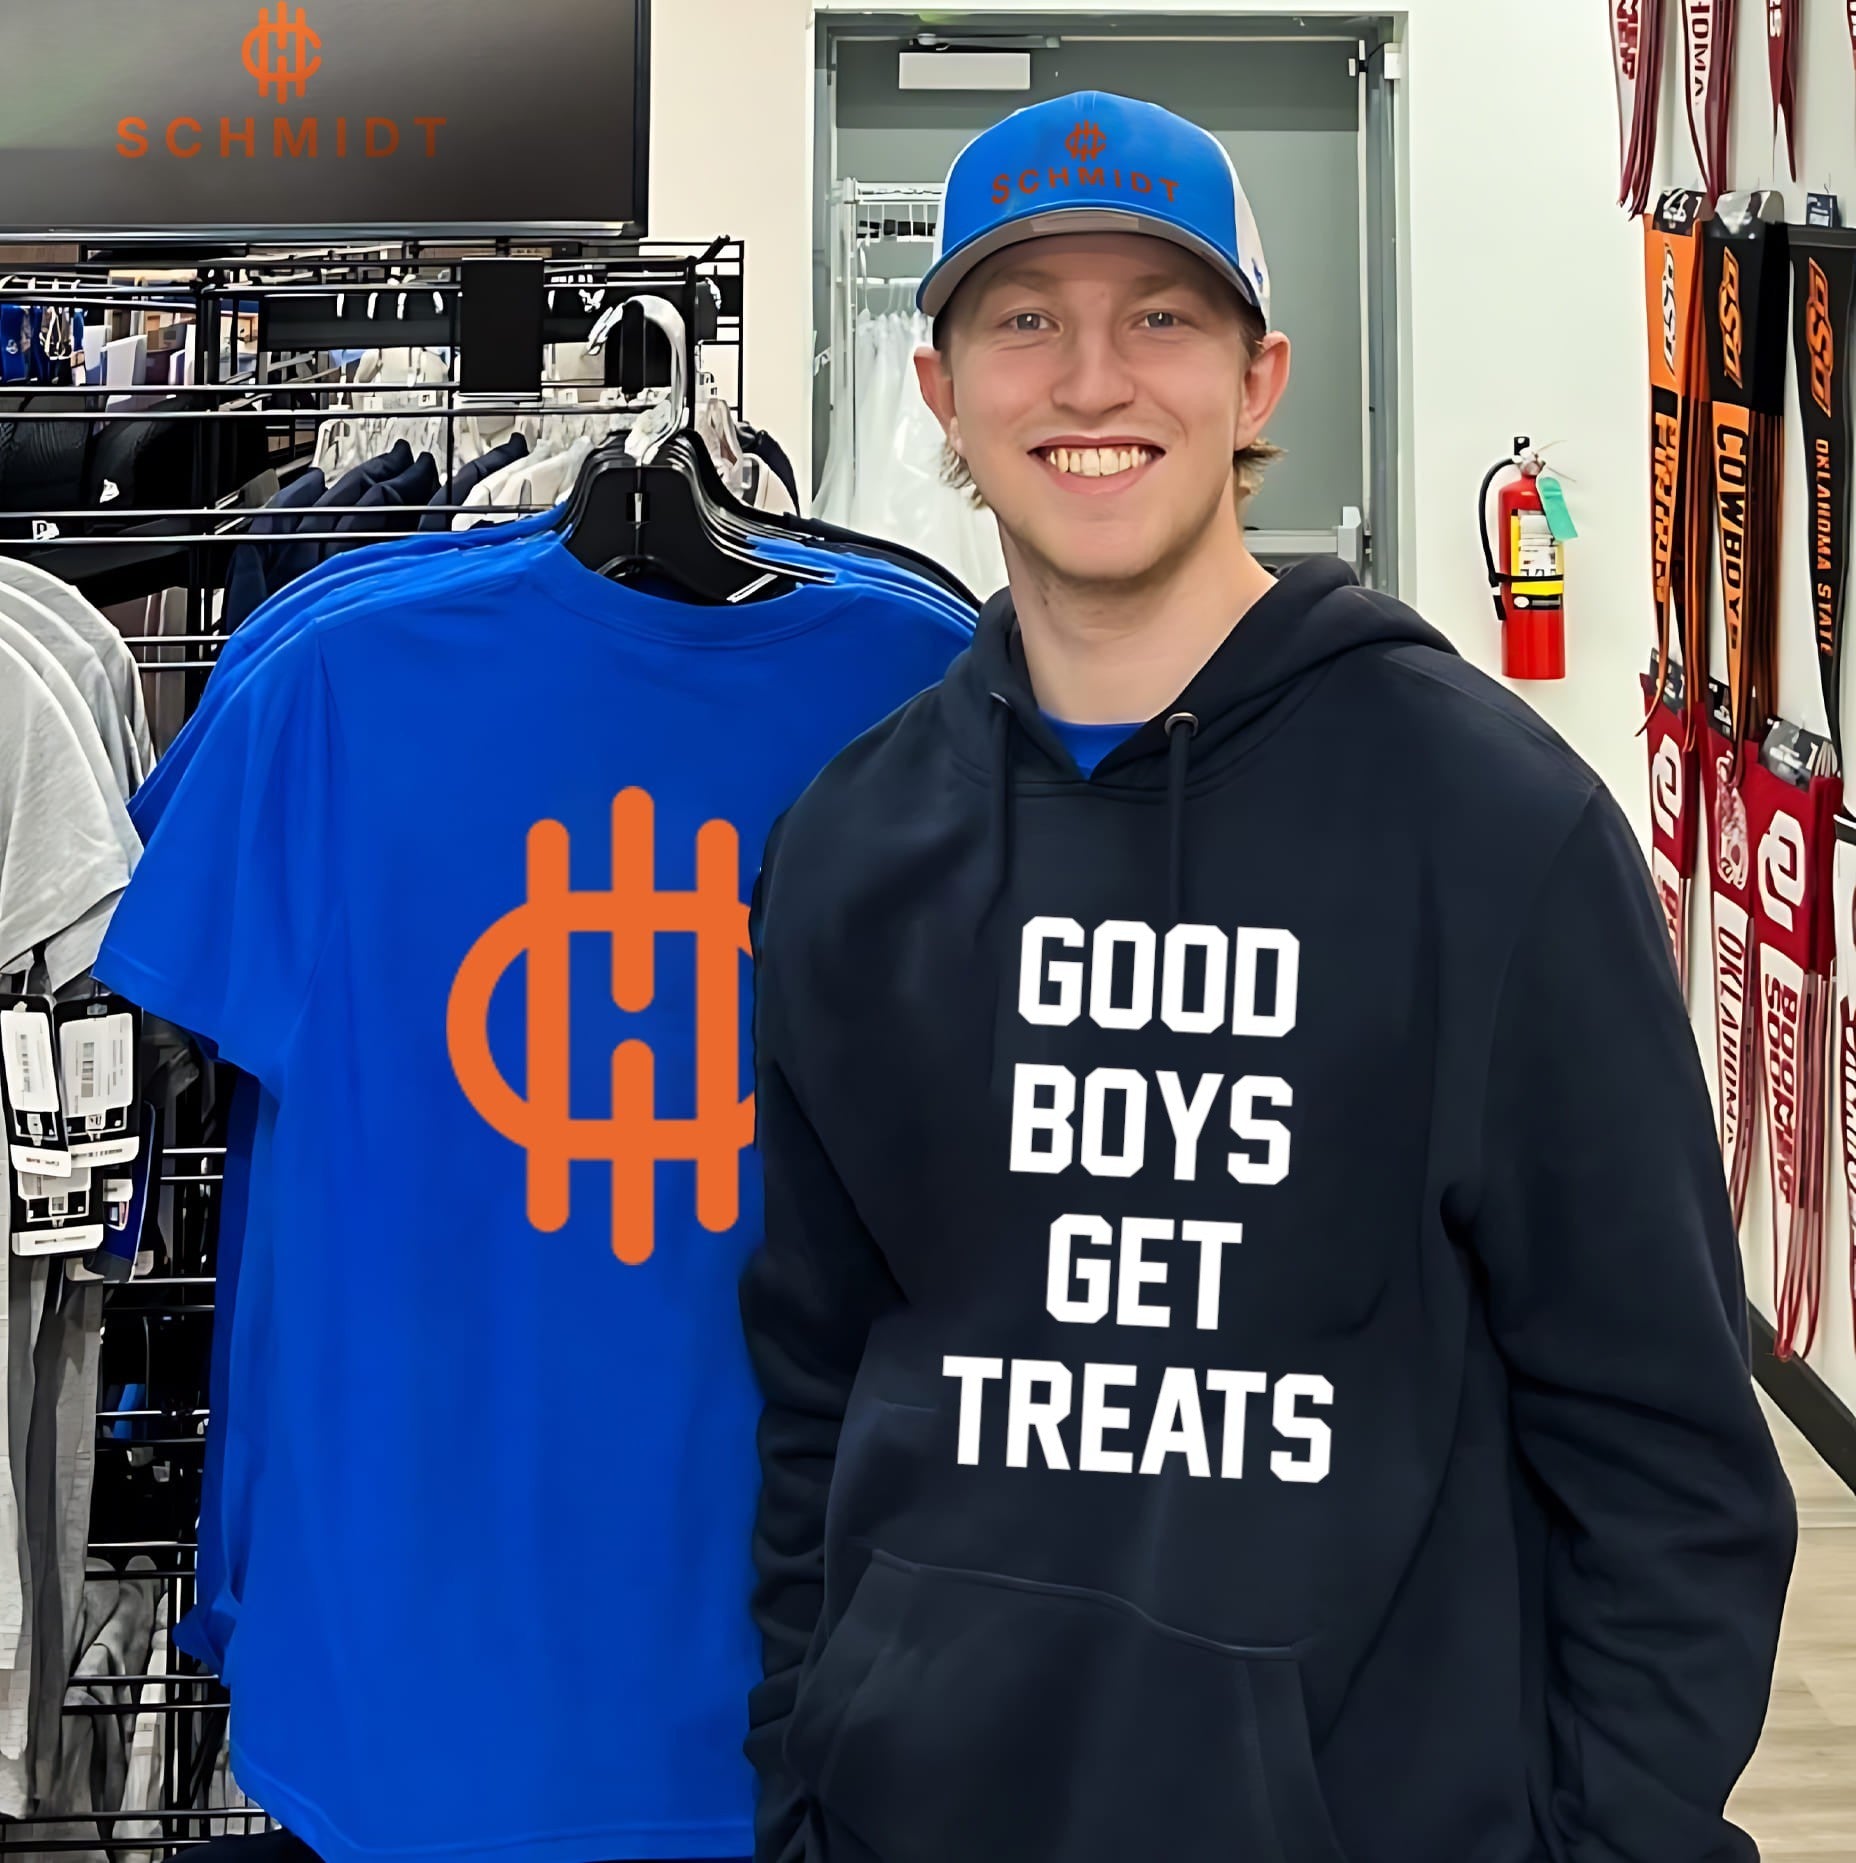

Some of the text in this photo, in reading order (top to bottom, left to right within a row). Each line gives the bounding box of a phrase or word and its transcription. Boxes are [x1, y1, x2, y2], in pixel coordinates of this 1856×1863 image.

[116, 116, 447, 158] SCHMIDT
[991, 167, 1180, 204] SCHMIDT
[1815, 438, 1832, 571] OKLAHOMA
[1018, 915, 1300, 1038] GOOD
[1010, 1062, 1293, 1186] BOYS
[1046, 1213, 1243, 1330] GET
[942, 1355, 1334, 1483] TREATS
